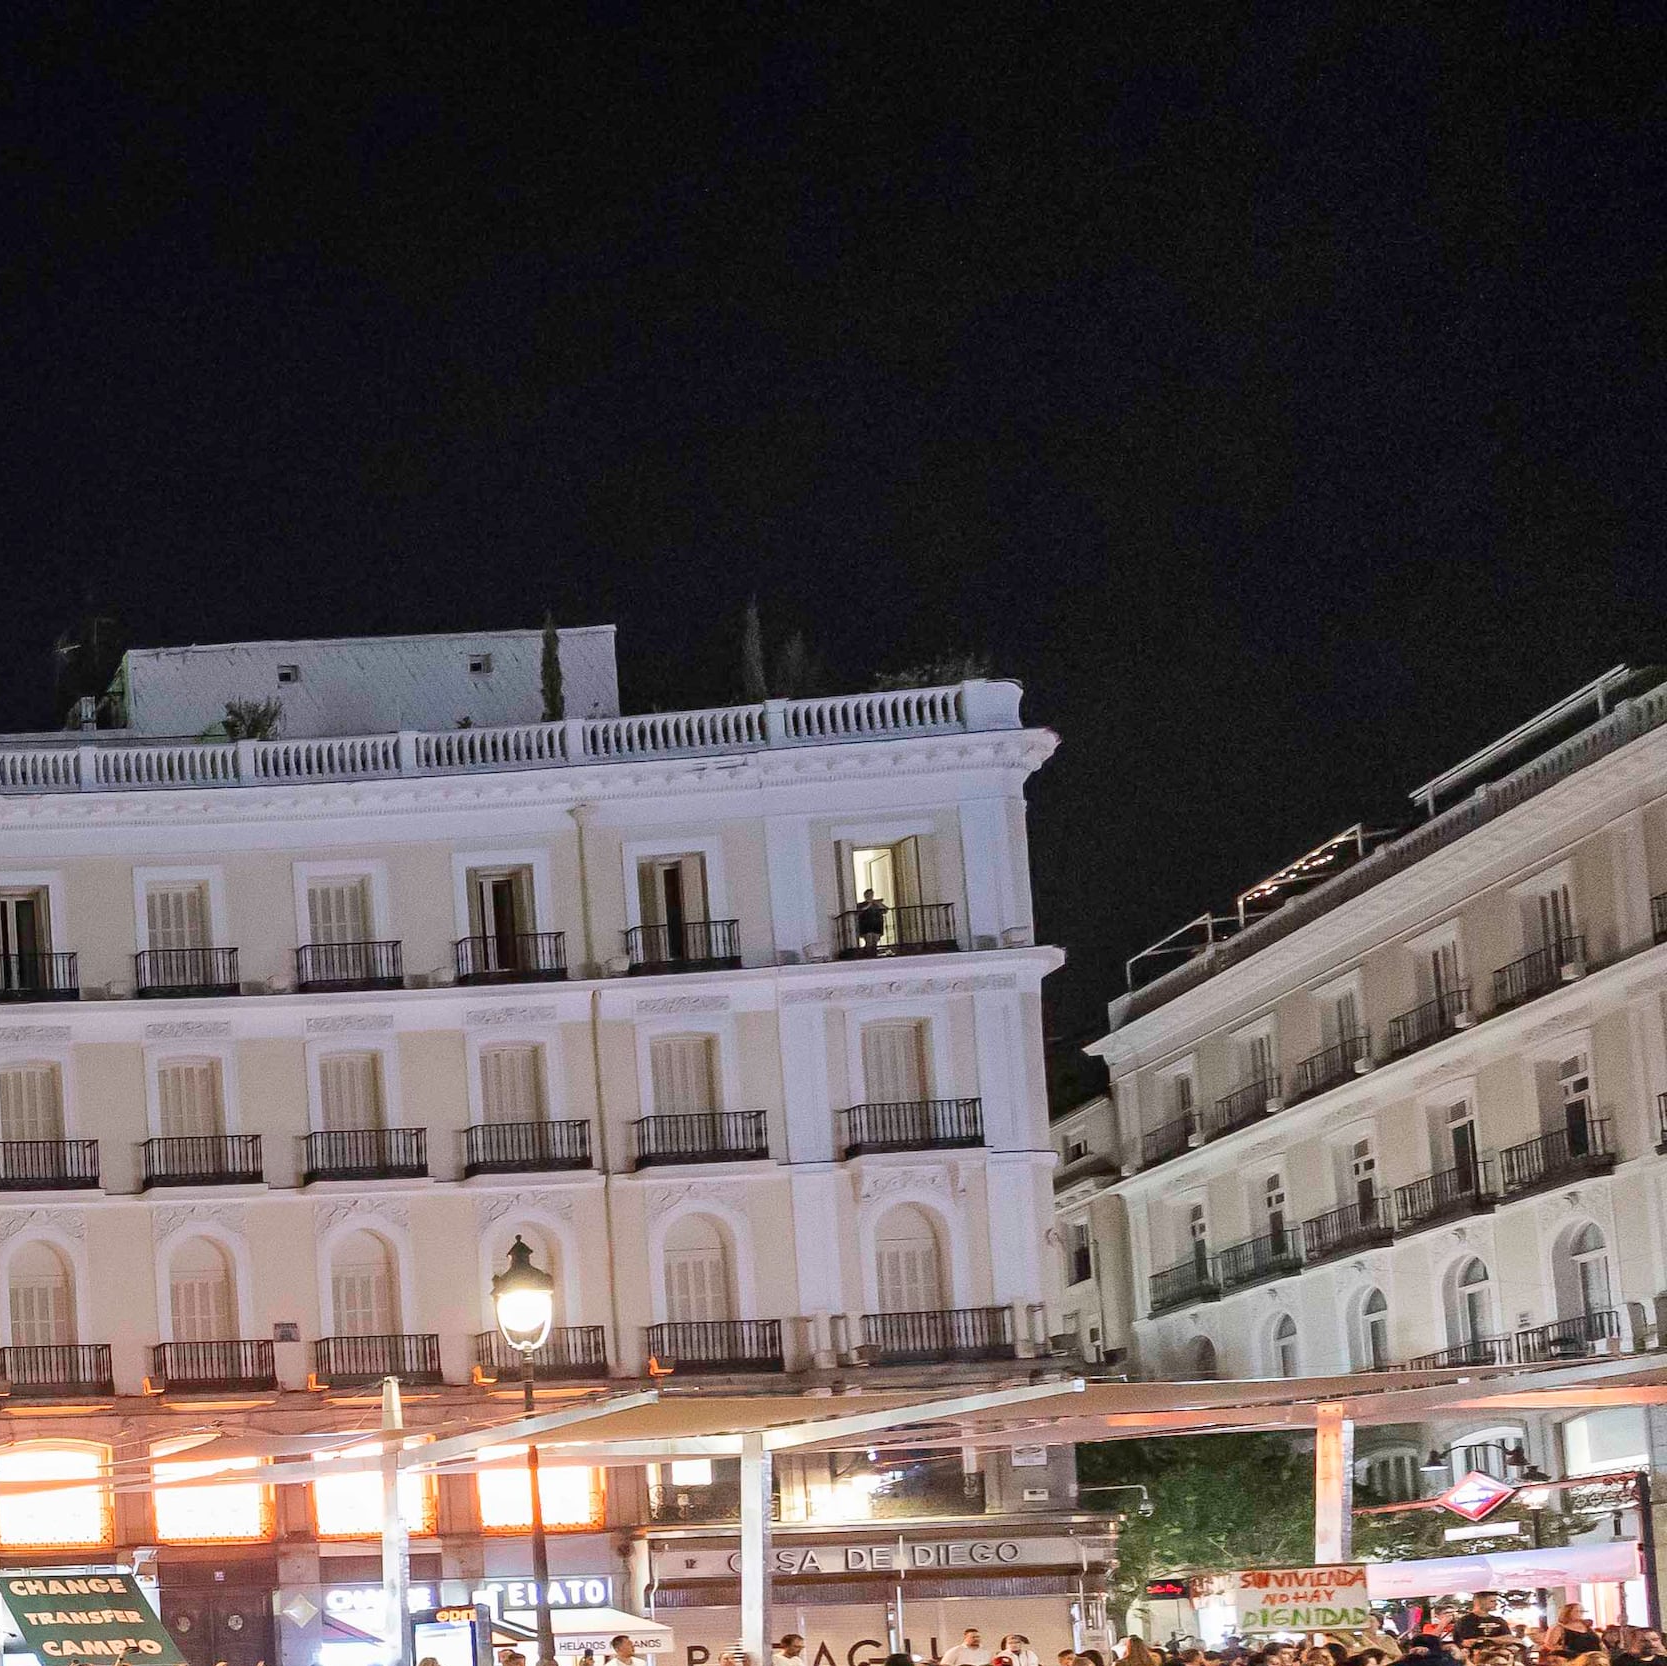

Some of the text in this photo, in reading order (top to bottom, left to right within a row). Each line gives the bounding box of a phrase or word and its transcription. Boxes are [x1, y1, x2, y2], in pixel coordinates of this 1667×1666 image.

[728, 1541, 1020, 1574] CSA DE DIEGO
[9, 1577, 127, 1596] CHANGE
[1267, 1567, 1366, 1588] VIVIENDA
[1261, 1589, 1336, 1605] NO HAY
[23, 1609, 145, 1626] TRANSFER
[1243, 1607, 1366, 1628] DIGNIDAD
[560, 1641, 606, 1651] HELADOS
